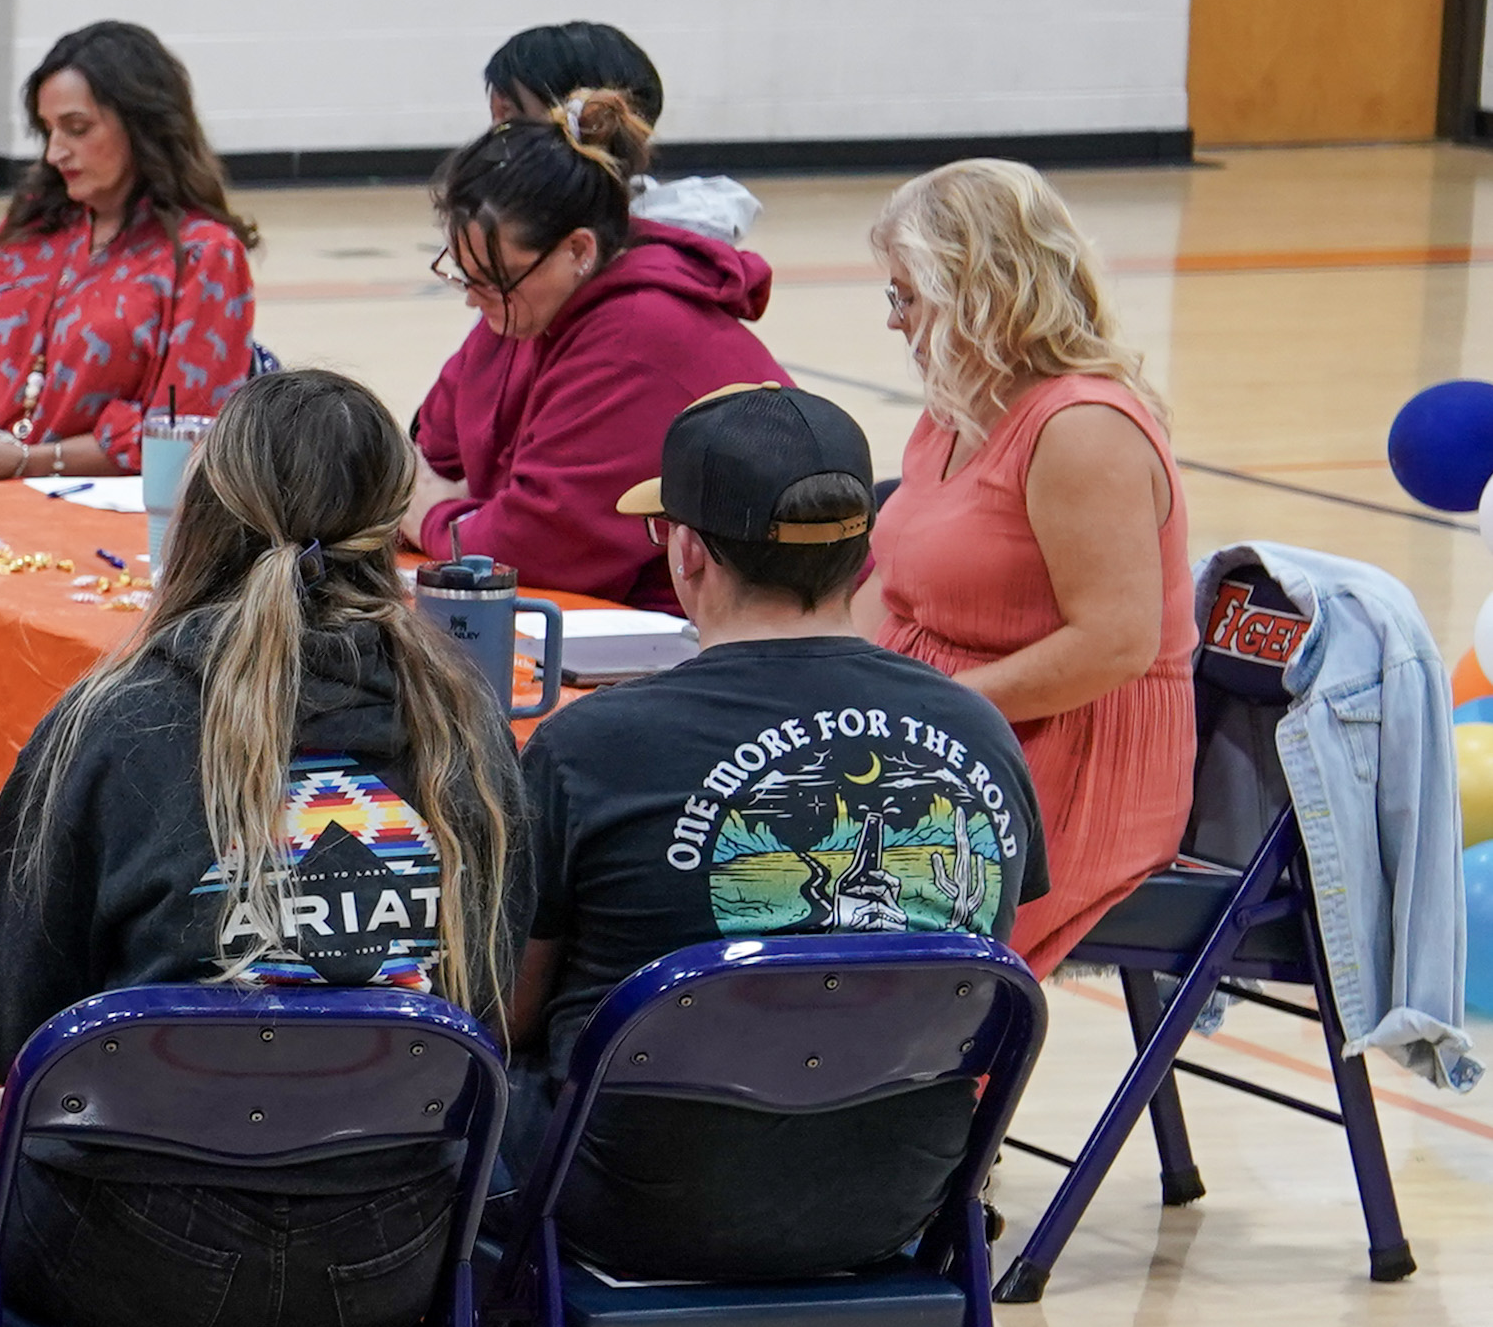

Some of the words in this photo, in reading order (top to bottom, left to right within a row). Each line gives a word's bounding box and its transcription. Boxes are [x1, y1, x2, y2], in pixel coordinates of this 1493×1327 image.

[666, 795, 720, 871] ONE
[702, 717, 812, 799] MORE
[813, 707, 892, 741] FOR
[899, 716, 969, 770] THE
[966, 760, 1019, 859] ROAD
[333, 870, 349, 879] TO
[221, 887, 441, 945] ARIAT
